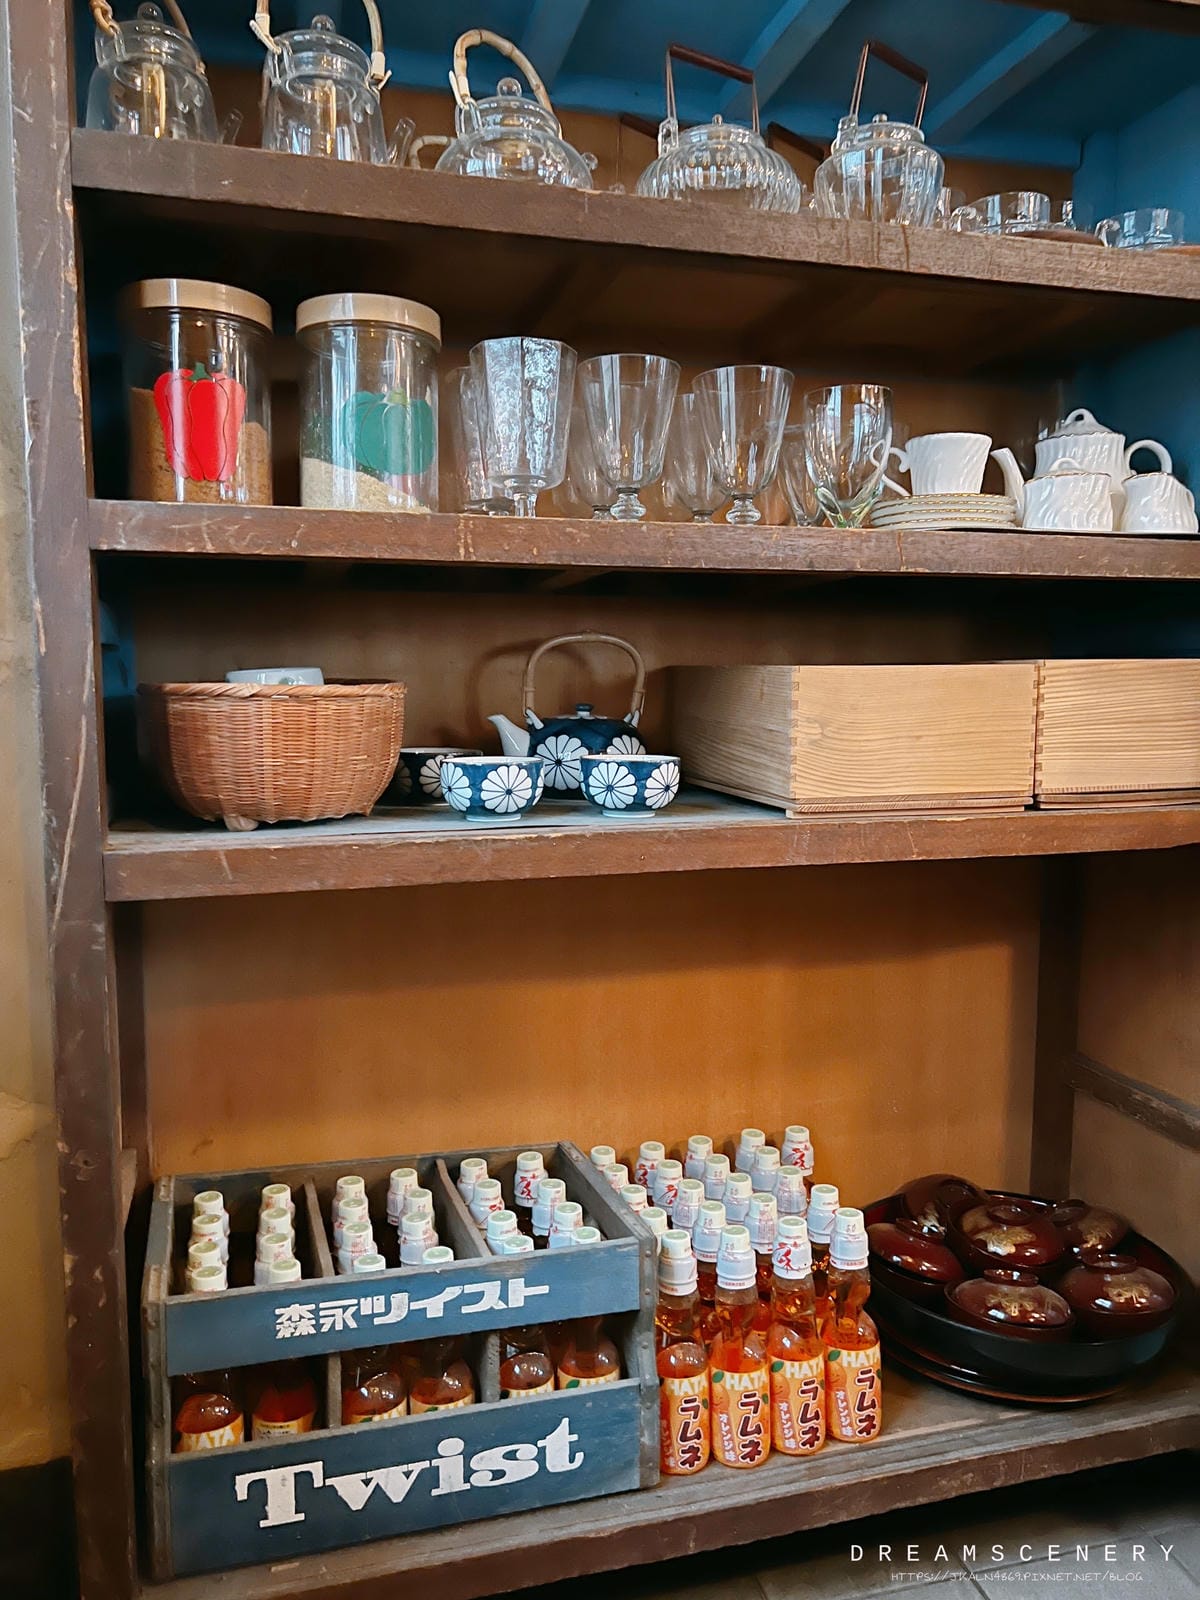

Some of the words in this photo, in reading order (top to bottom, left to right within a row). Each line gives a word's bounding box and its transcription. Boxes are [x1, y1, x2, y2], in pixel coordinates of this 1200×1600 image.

[274, 1278, 550, 1340] 森永ツイスト
[678, 1396, 702, 1469] ラムネ
[738, 1391, 762, 1463] ラムネ
[798, 1378, 820, 1449] ラムネ
[855, 1367, 877, 1436] ラムネ
[234, 1417, 584, 1528] Twist
